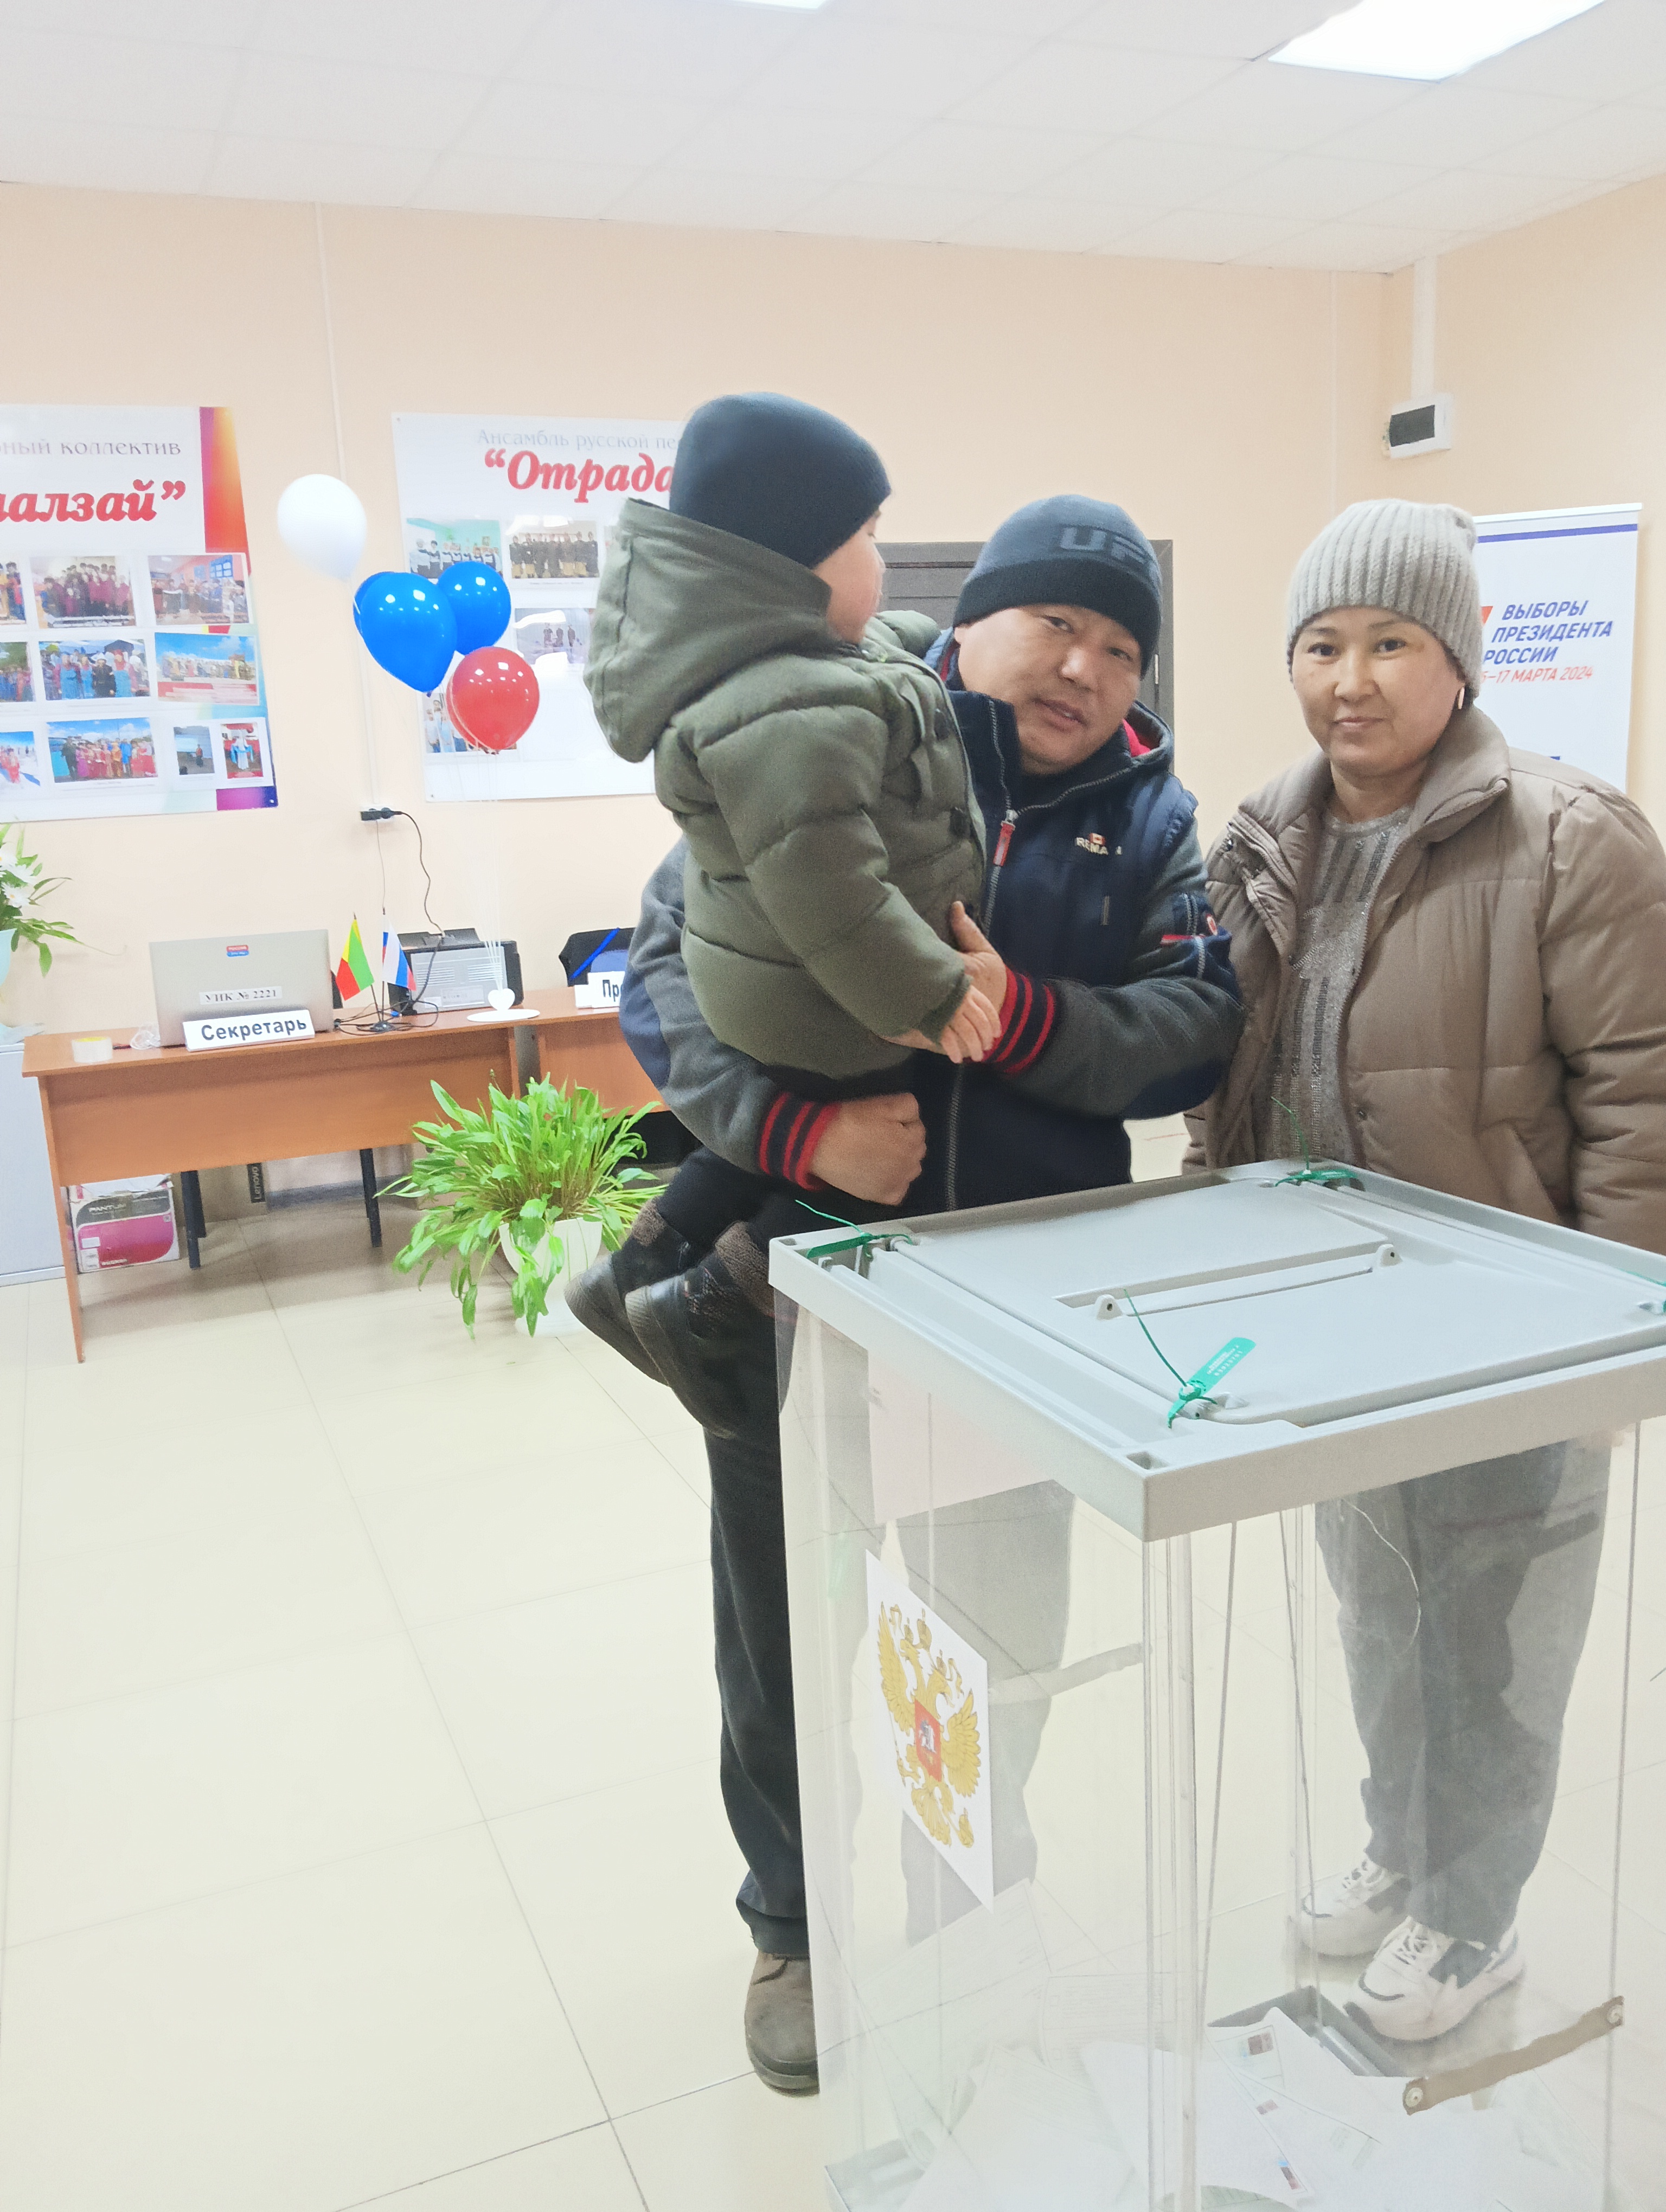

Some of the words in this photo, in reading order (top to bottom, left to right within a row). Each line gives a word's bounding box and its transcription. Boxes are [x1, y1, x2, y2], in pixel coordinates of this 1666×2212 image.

[0, 439, 52, 455] ный
[477, 429, 569, 445] Ансамбль
[577, 433, 649, 451] русской
[656, 438, 679, 449] пе
[1502, 600, 1589, 621] ВЫБОРЫ
[1491, 620, 1613, 643] ПРЕЗИДЕНТА
[1483, 646, 1559, 665] РОССИИ
[1511, 667, 1558, 683] МАРТА
[1559, 665, 1594, 681] 2024
[206, 993, 233, 1002] УИК
[238, 992, 249, 1000] №
[253, 989, 277, 999] 2221
[602, 979, 623, 1002] Пр
[201, 1019, 307, 1041] Секретарь
[252, 1166, 261, 1199] Lenovo
